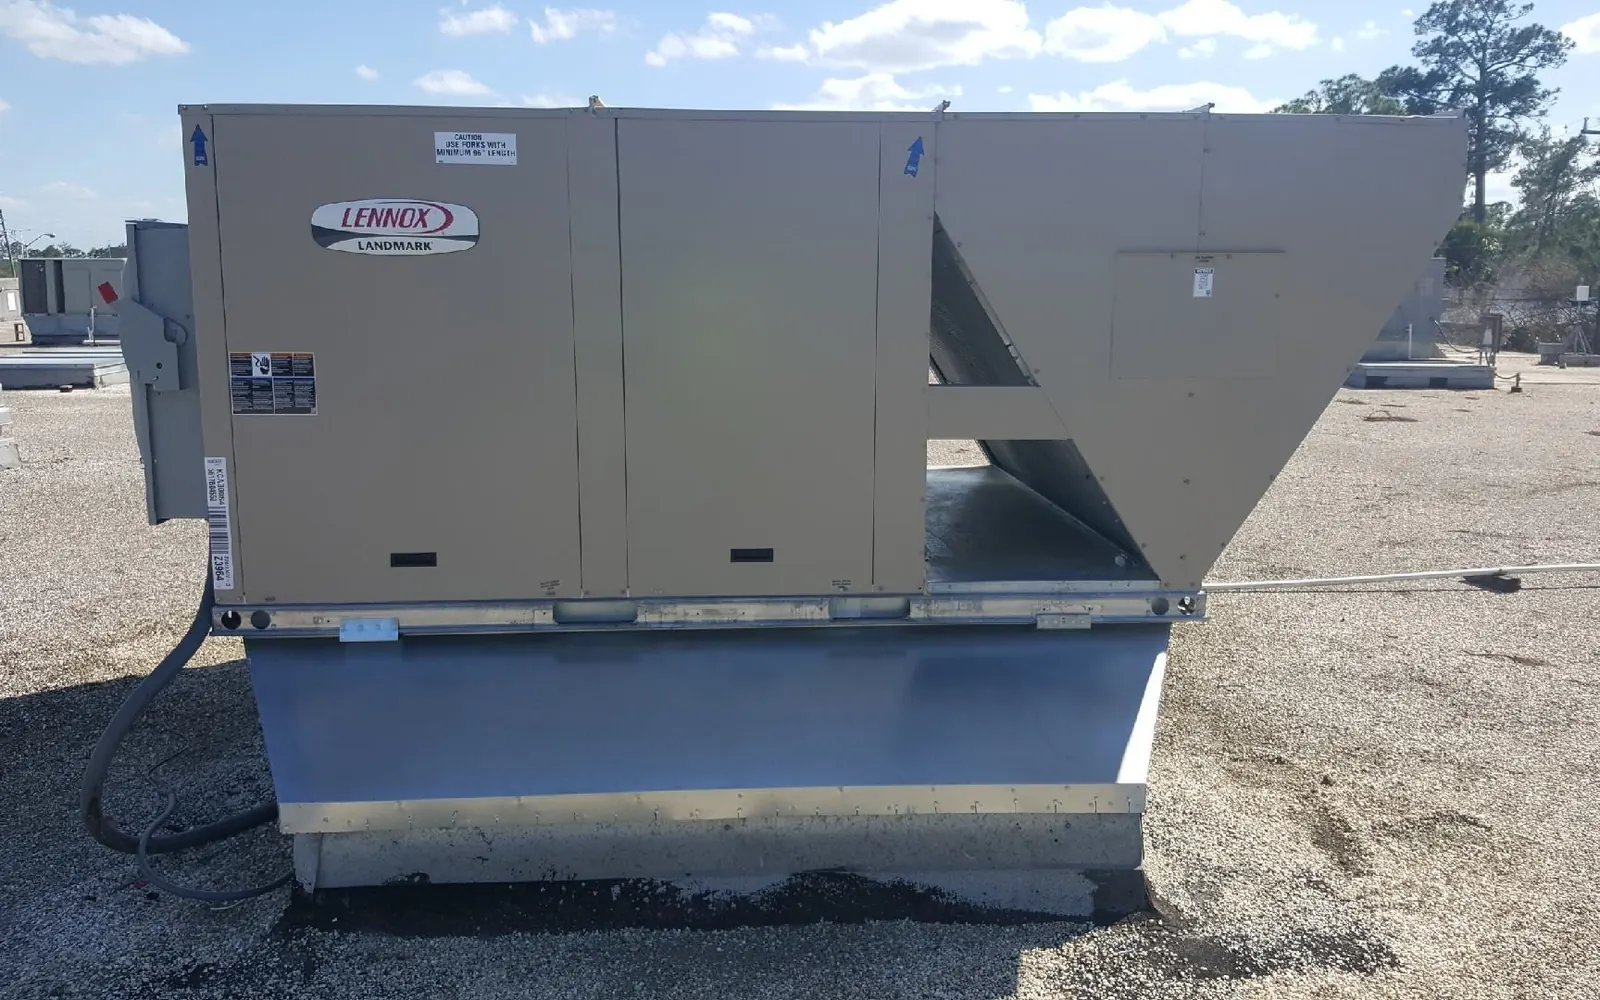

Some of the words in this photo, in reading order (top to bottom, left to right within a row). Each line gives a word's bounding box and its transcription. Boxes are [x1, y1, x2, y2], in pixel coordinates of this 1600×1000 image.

[454, 133, 482, 141] CAUTION
[461, 141, 486, 149] FORKS
[487, 141, 506, 149] WITH
[436, 148, 471, 156] MINIMUM
[341, 207, 432, 229] LENNOX
[357, 241, 432, 251] LANDMARK
[214, 555, 224, 581] Z3964
